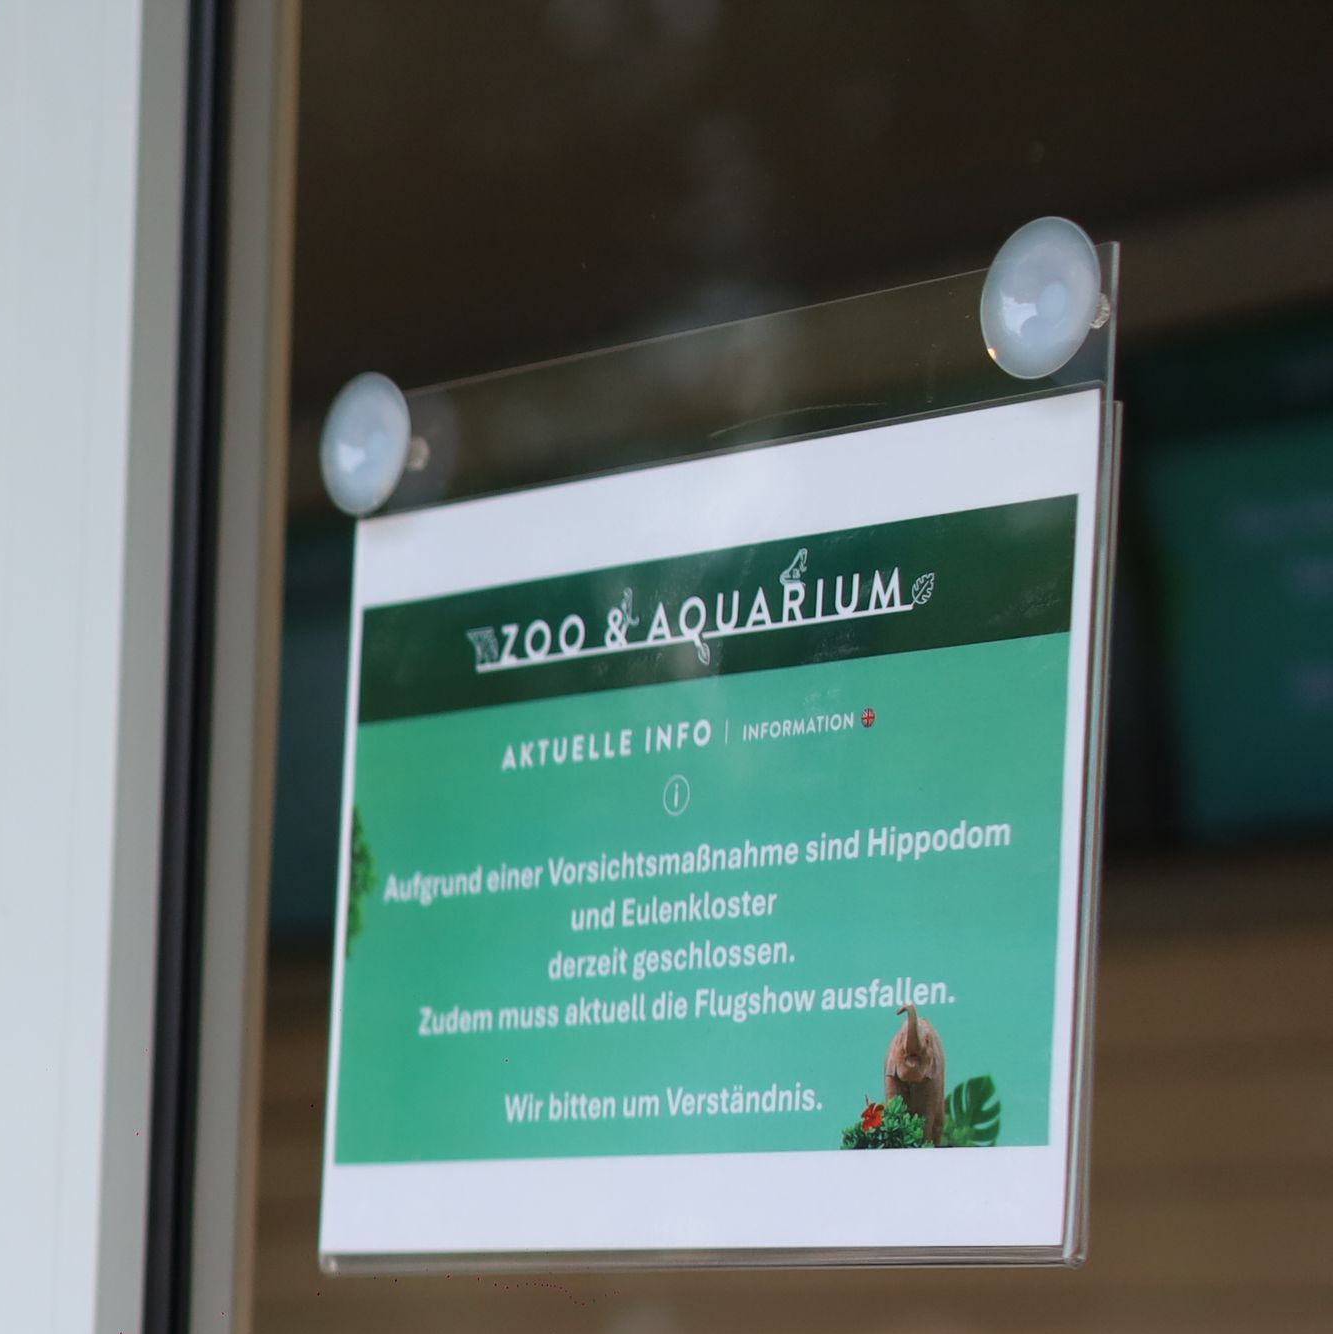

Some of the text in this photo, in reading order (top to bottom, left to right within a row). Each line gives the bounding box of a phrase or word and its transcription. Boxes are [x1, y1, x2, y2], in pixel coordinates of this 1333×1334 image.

[500, 567, 902, 663] ZOO & AQUARIUM
[501, 712, 855, 771] AKTUELLE INFO INFORMATION
[384, 820, 1012, 905] Aufgrund einer Vorsichtsmaßnahme sind Hippodom
[571, 891, 777, 931] und Eulenkloster
[548, 940, 795, 980] derzeit geschlossen.
[419, 977, 955, 1036] Zudem muss aktuell die Flugshow ausfallen.
[504, 1082, 823, 1122] Wir bitten um Verständnis.
